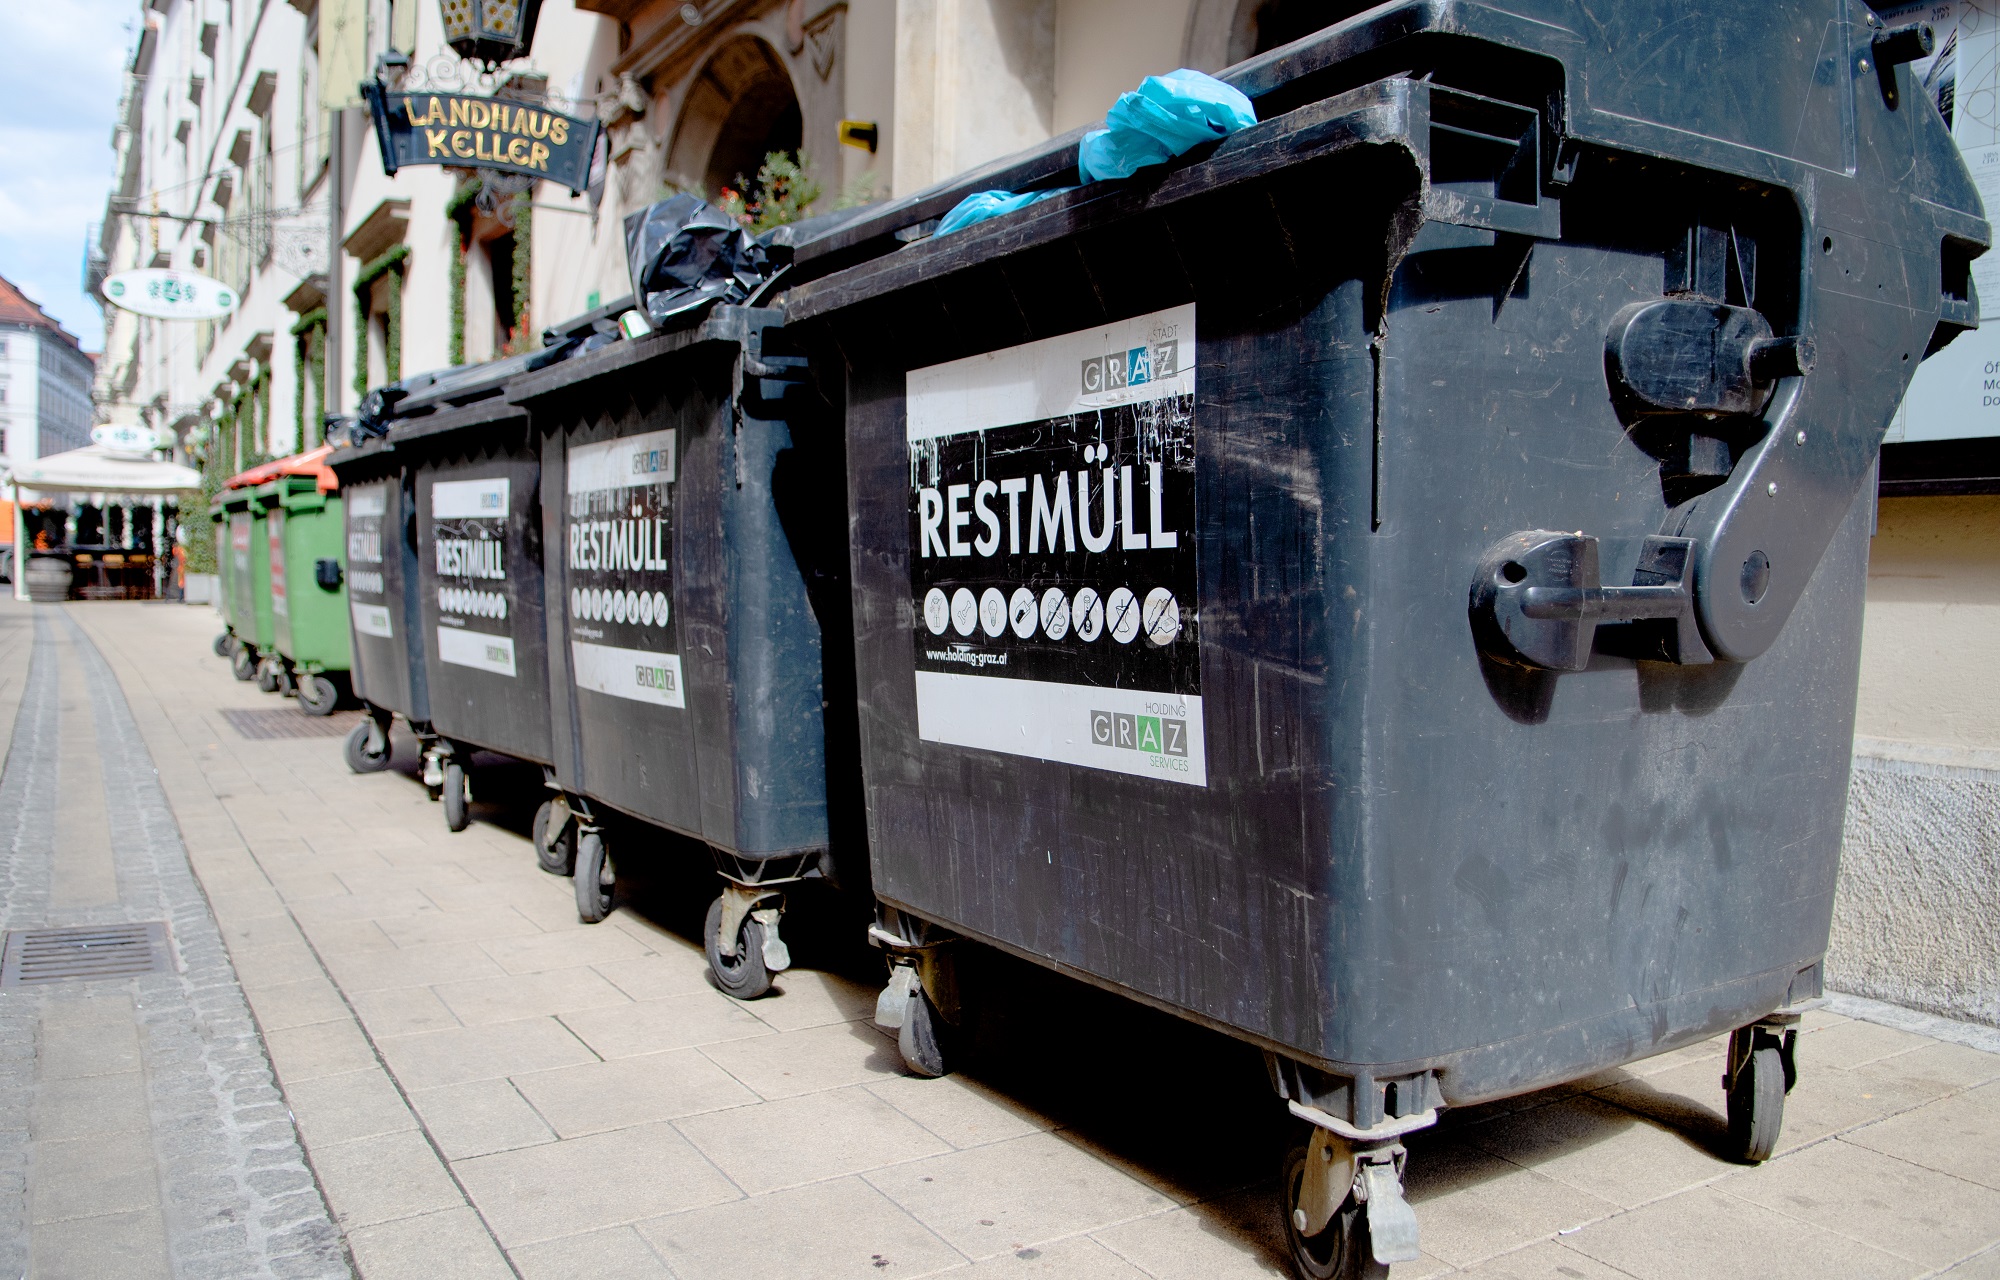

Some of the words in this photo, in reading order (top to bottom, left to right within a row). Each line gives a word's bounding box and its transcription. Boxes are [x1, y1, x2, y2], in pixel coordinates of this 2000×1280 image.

[404, 96, 570, 146] LANDHAUS
[425, 129, 550, 172] KELLER
[1152, 324, 1178, 340] STADT
[1083, 344, 1174, 391] GRAZ
[633, 450, 668, 474] GRAZ
[919, 443, 1177, 558] RESTMÜLL
[436, 530, 506, 579] RESTMÜLL
[570, 504, 667, 571] RESTMÜLL
[926, 646, 1007, 667] www.holding-graz.at
[636, 666, 675, 690] GRAZ
[1145, 702, 1186, 717] HOLDING
[1093, 715, 1183, 753] GRAZ
[1150, 755, 1188, 772] SERVICES
